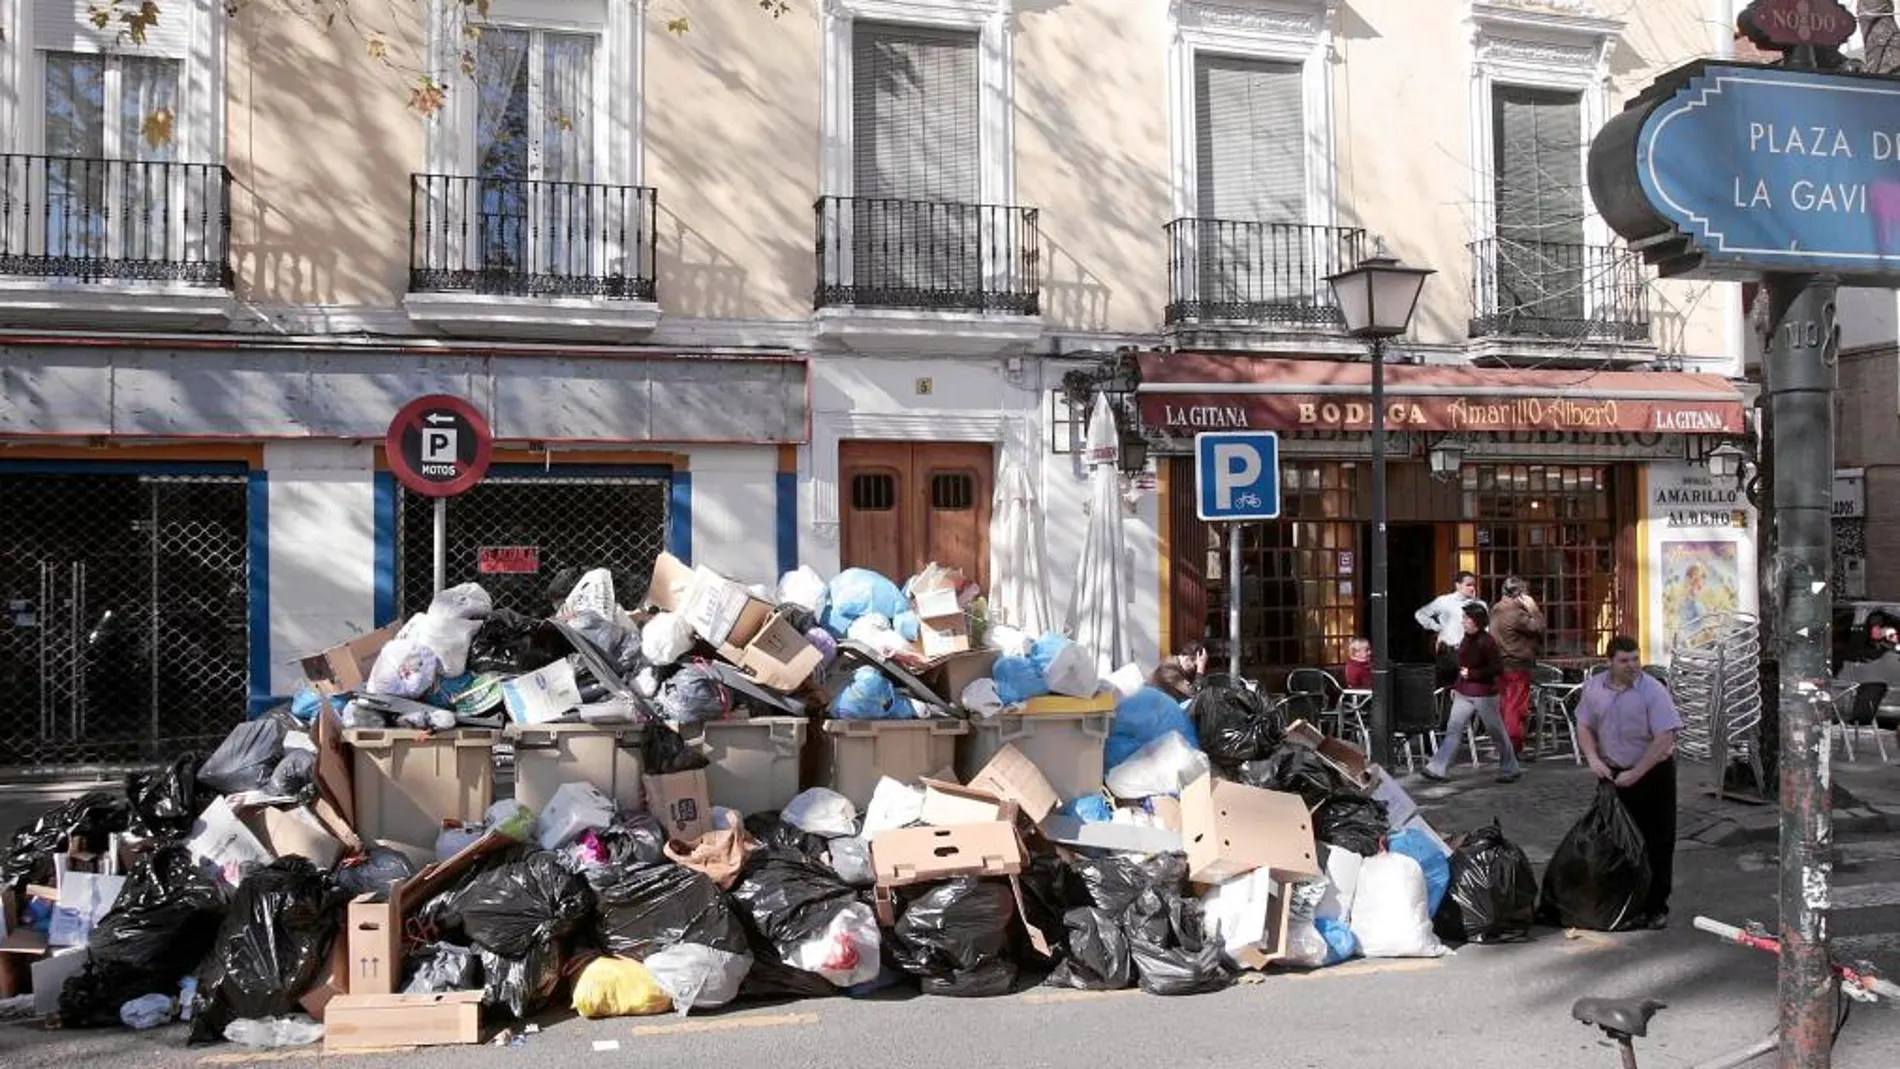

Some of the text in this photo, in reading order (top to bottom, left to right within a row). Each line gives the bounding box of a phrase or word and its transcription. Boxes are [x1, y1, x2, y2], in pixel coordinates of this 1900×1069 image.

[1751, 123, 1852, 158] PLAZA
[1735, 176, 1866, 213] LA GAVI
[1189, 405, 1249, 428] GITANA
[1675, 410, 1722, 430] GITANA
[430, 434, 449, 457] P
[421, 464, 456, 477] MOTOS
[1213, 443, 1262, 510] P
[1656, 489, 1737, 503] AMARILLO
